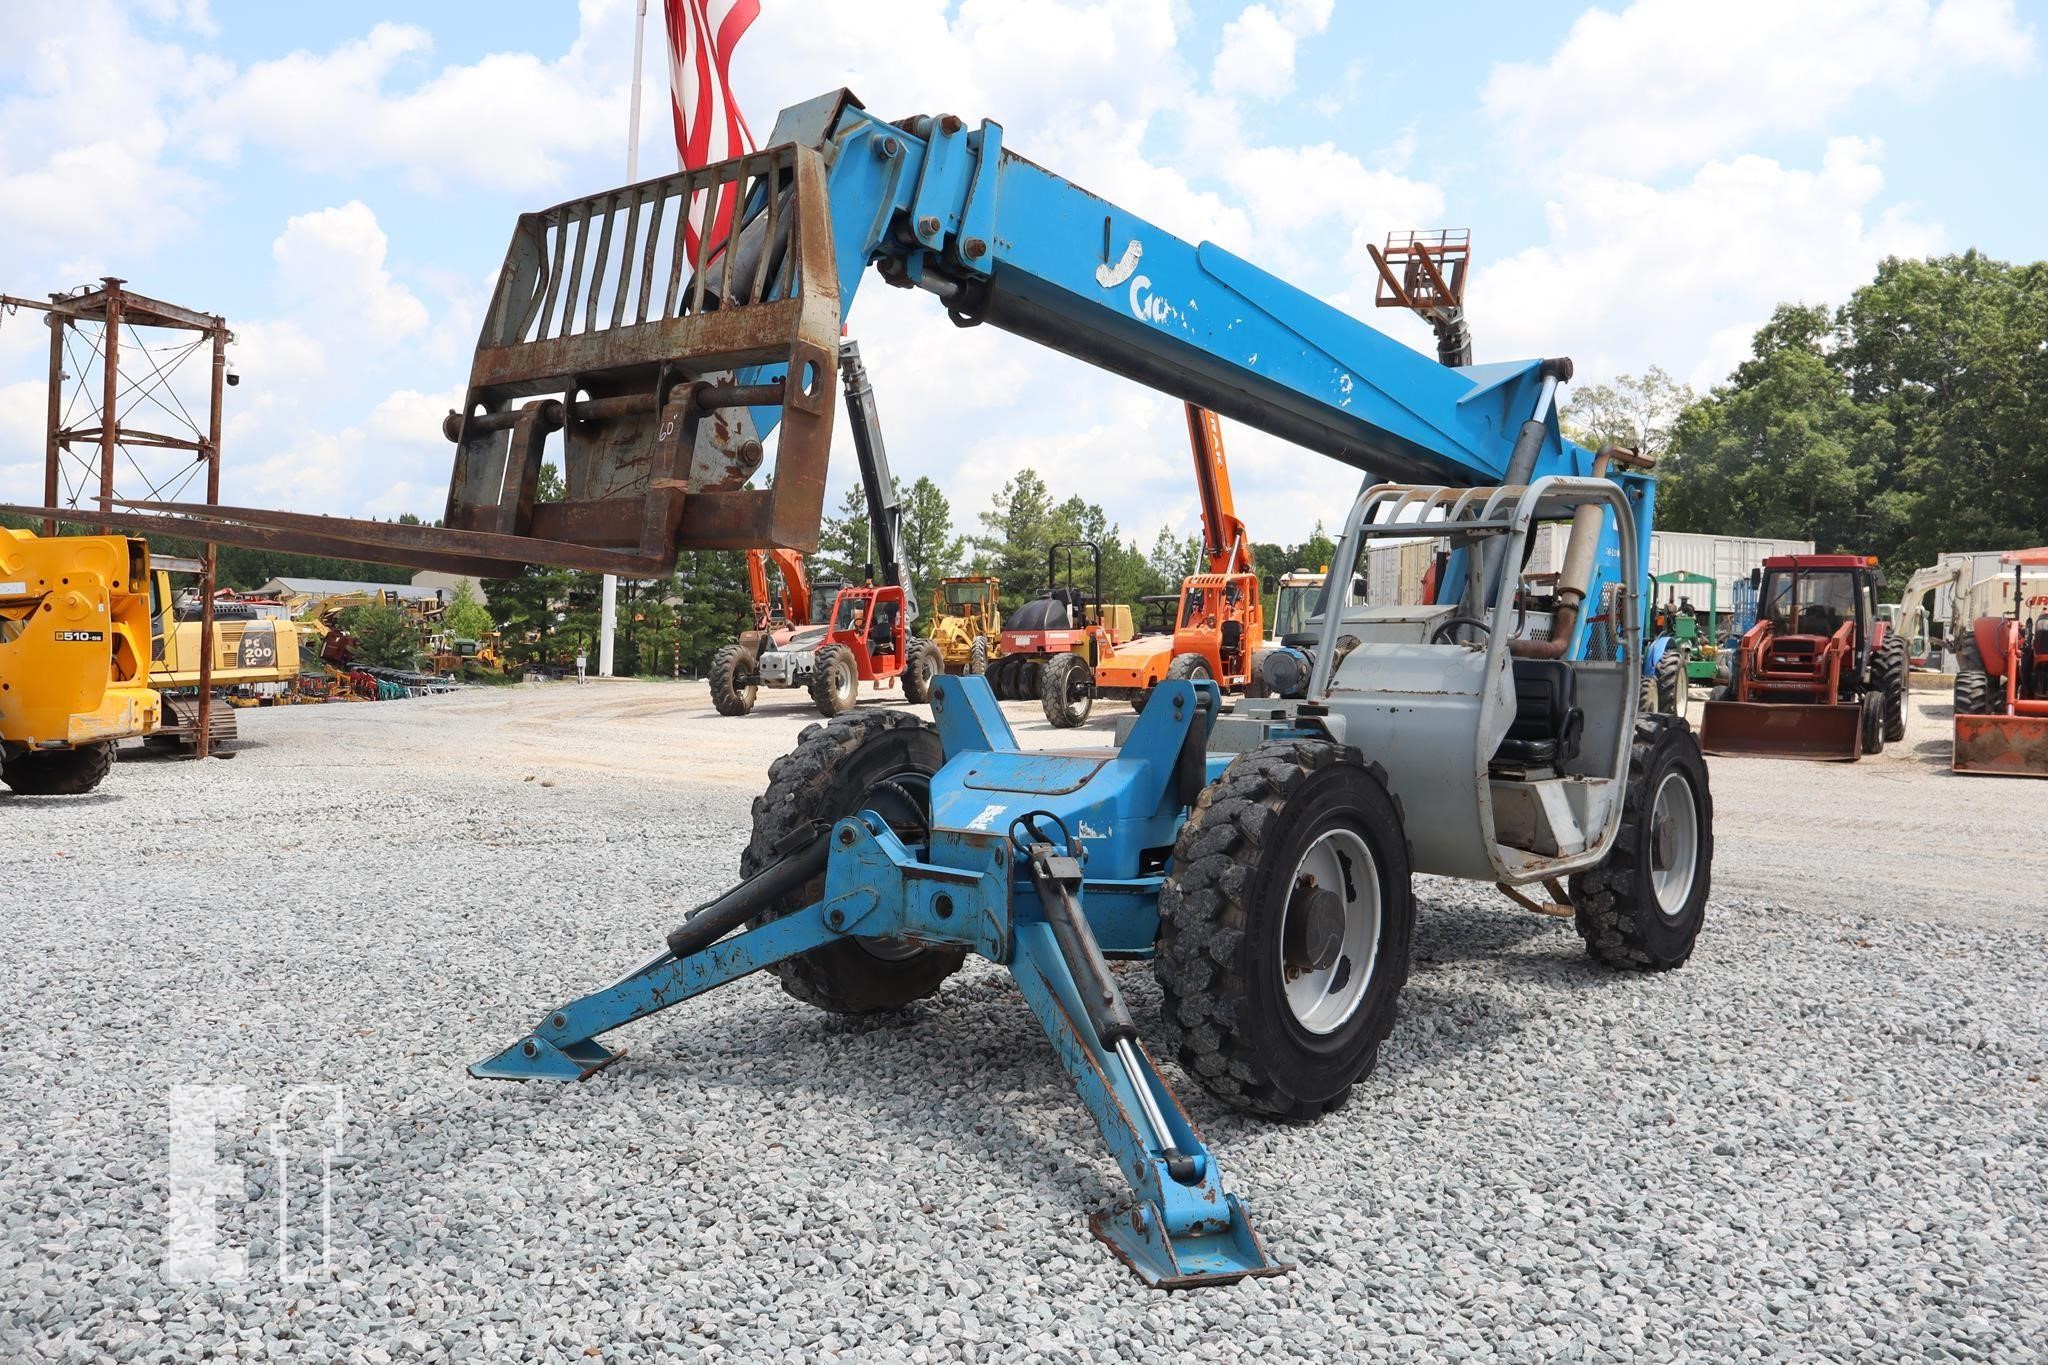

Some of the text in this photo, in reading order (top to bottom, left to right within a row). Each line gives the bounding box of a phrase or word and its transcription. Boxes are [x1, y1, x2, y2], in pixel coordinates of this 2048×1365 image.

[244, 638, 260, 648] PC
[245, 647, 272, 658] 200
[245, 658, 257, 666] LC
